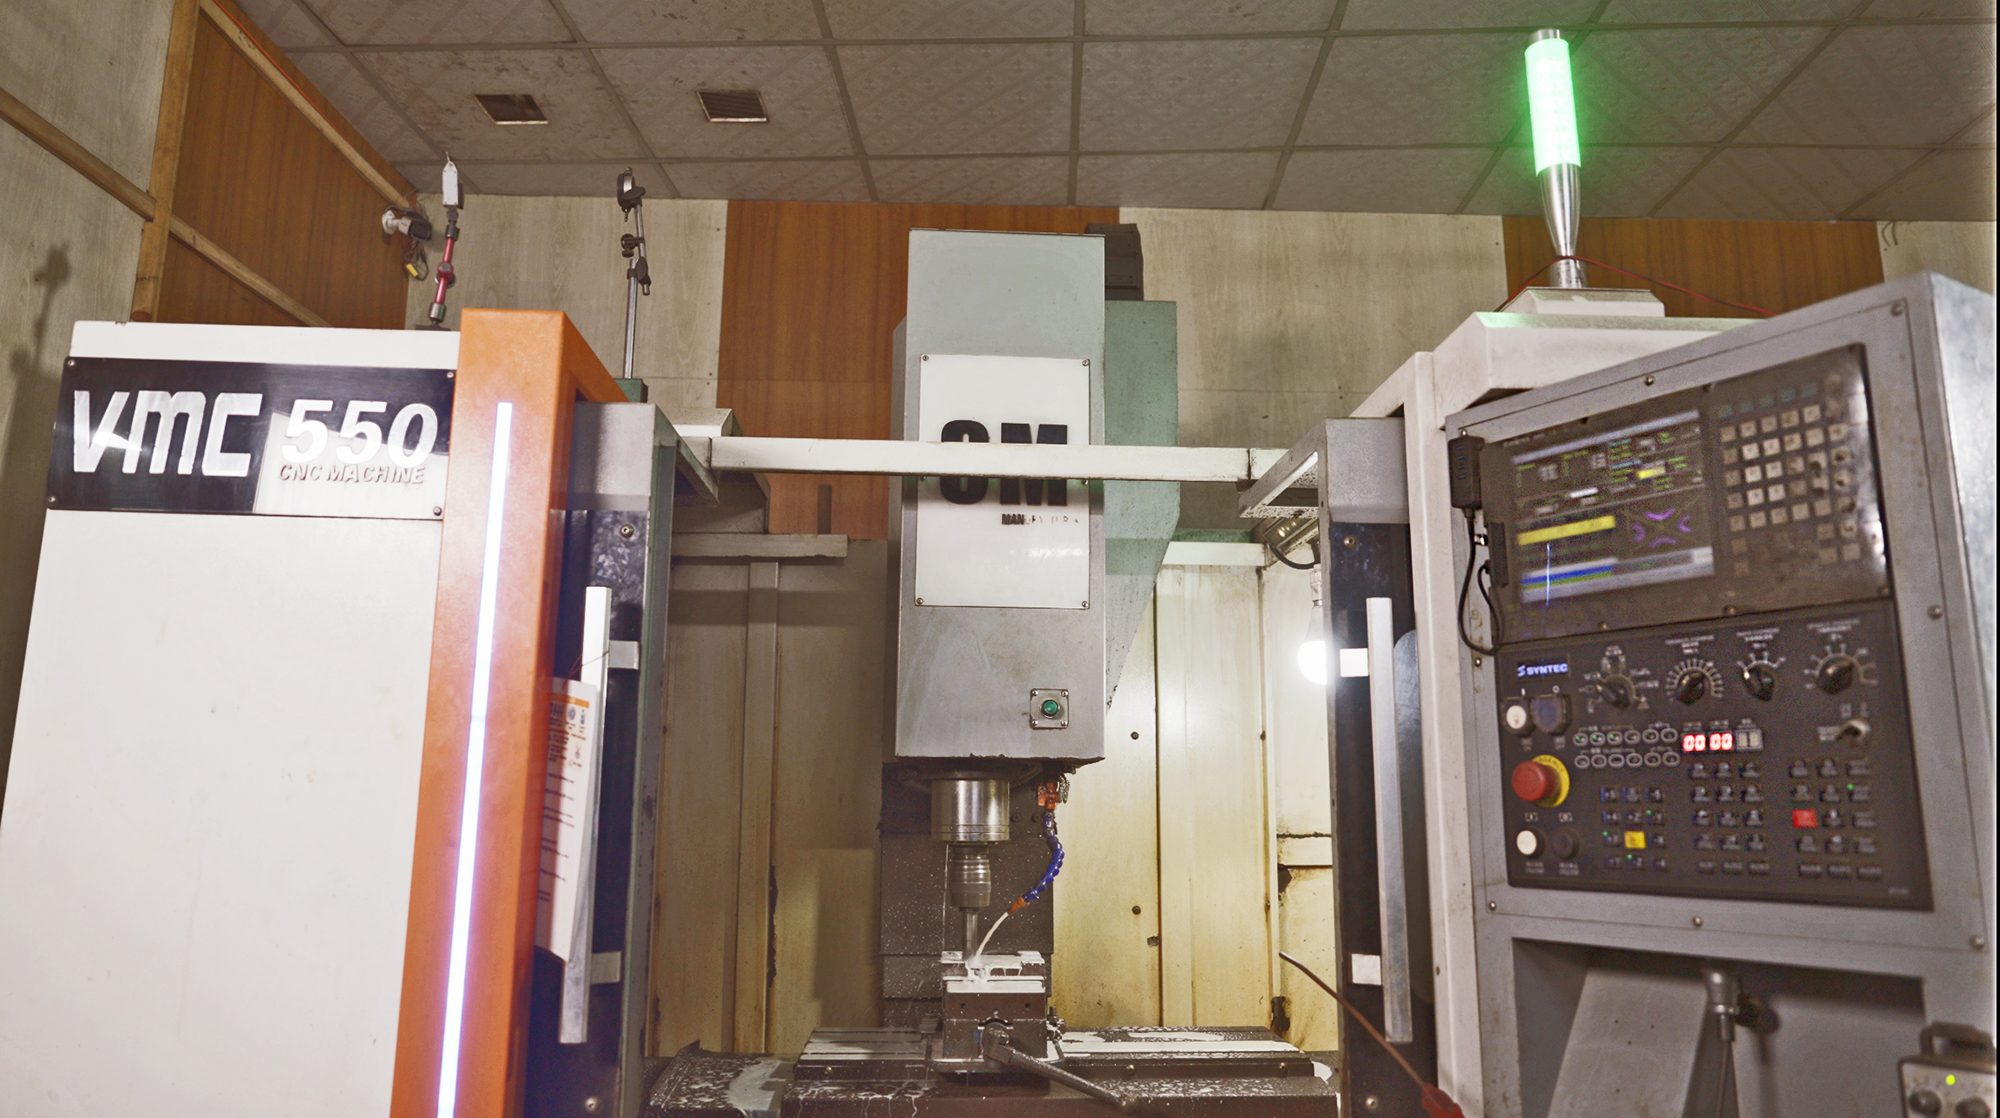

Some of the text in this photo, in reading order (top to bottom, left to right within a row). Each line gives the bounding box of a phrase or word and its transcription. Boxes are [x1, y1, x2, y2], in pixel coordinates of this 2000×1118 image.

[73, 390, 439, 477] VMC 550
[279, 464, 426, 485] CNC MACHINE
[1526, 663, 1569, 676] SYNTEC
